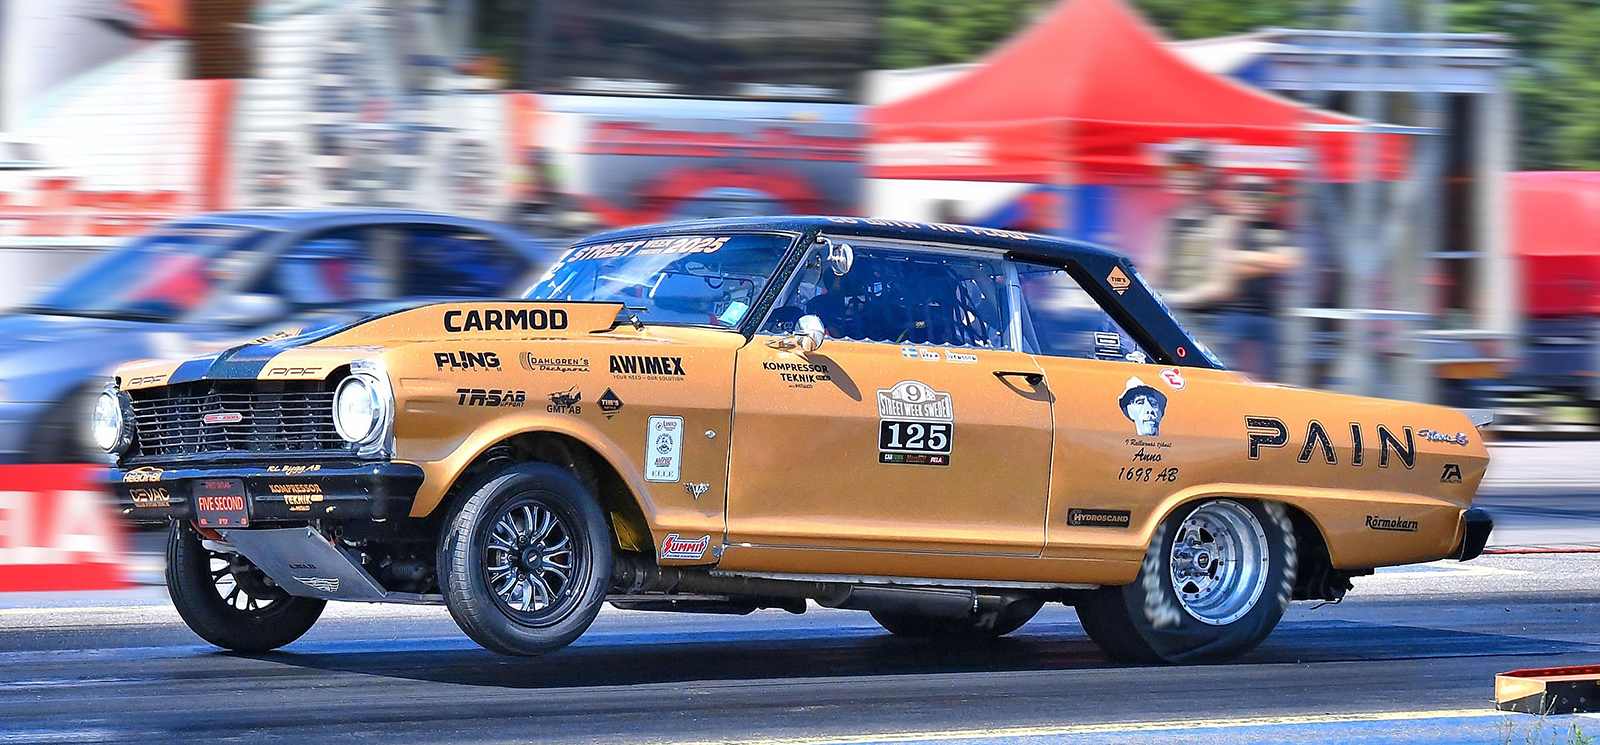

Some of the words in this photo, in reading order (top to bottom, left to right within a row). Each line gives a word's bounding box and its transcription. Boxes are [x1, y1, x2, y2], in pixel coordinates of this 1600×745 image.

[567, 241, 646, 262] STREET
[663, 237, 731, 254] 2025
[444, 309, 568, 332] CARMOD
[609, 355, 687, 376] AWIMEX
[762, 362, 830, 374] KOMPRESSOR
[780, 373, 816, 383] TEKNIK
[906, 384, 921, 402] 9
[546, 404, 567, 414] GMT
[568, 405, 582, 415] AB
[880, 397, 904, 416] STREET
[903, 402, 923, 417] WEEK
[923, 397, 951, 418] SWEDEN
[887, 423, 948, 451] 125
[1244, 414, 1416, 470] PAIN
[1132, 447, 1162, 462] Anno
[1118, 467, 1154, 482] 1698
[1154, 467, 1179, 482] AB
[129, 488, 171, 502] CEVAC
[268, 483, 323, 493] KOMPRESSOR
[197, 496, 215, 511] FIVE
[213, 496, 244, 511] SECOND
[283, 494, 313, 504] TEKNIK
[1073, 513, 1129, 523] HYDROSCAND
[1364, 515, 1419, 532] Rörmokarn
[663, 536, 705, 553] SUMMIT
